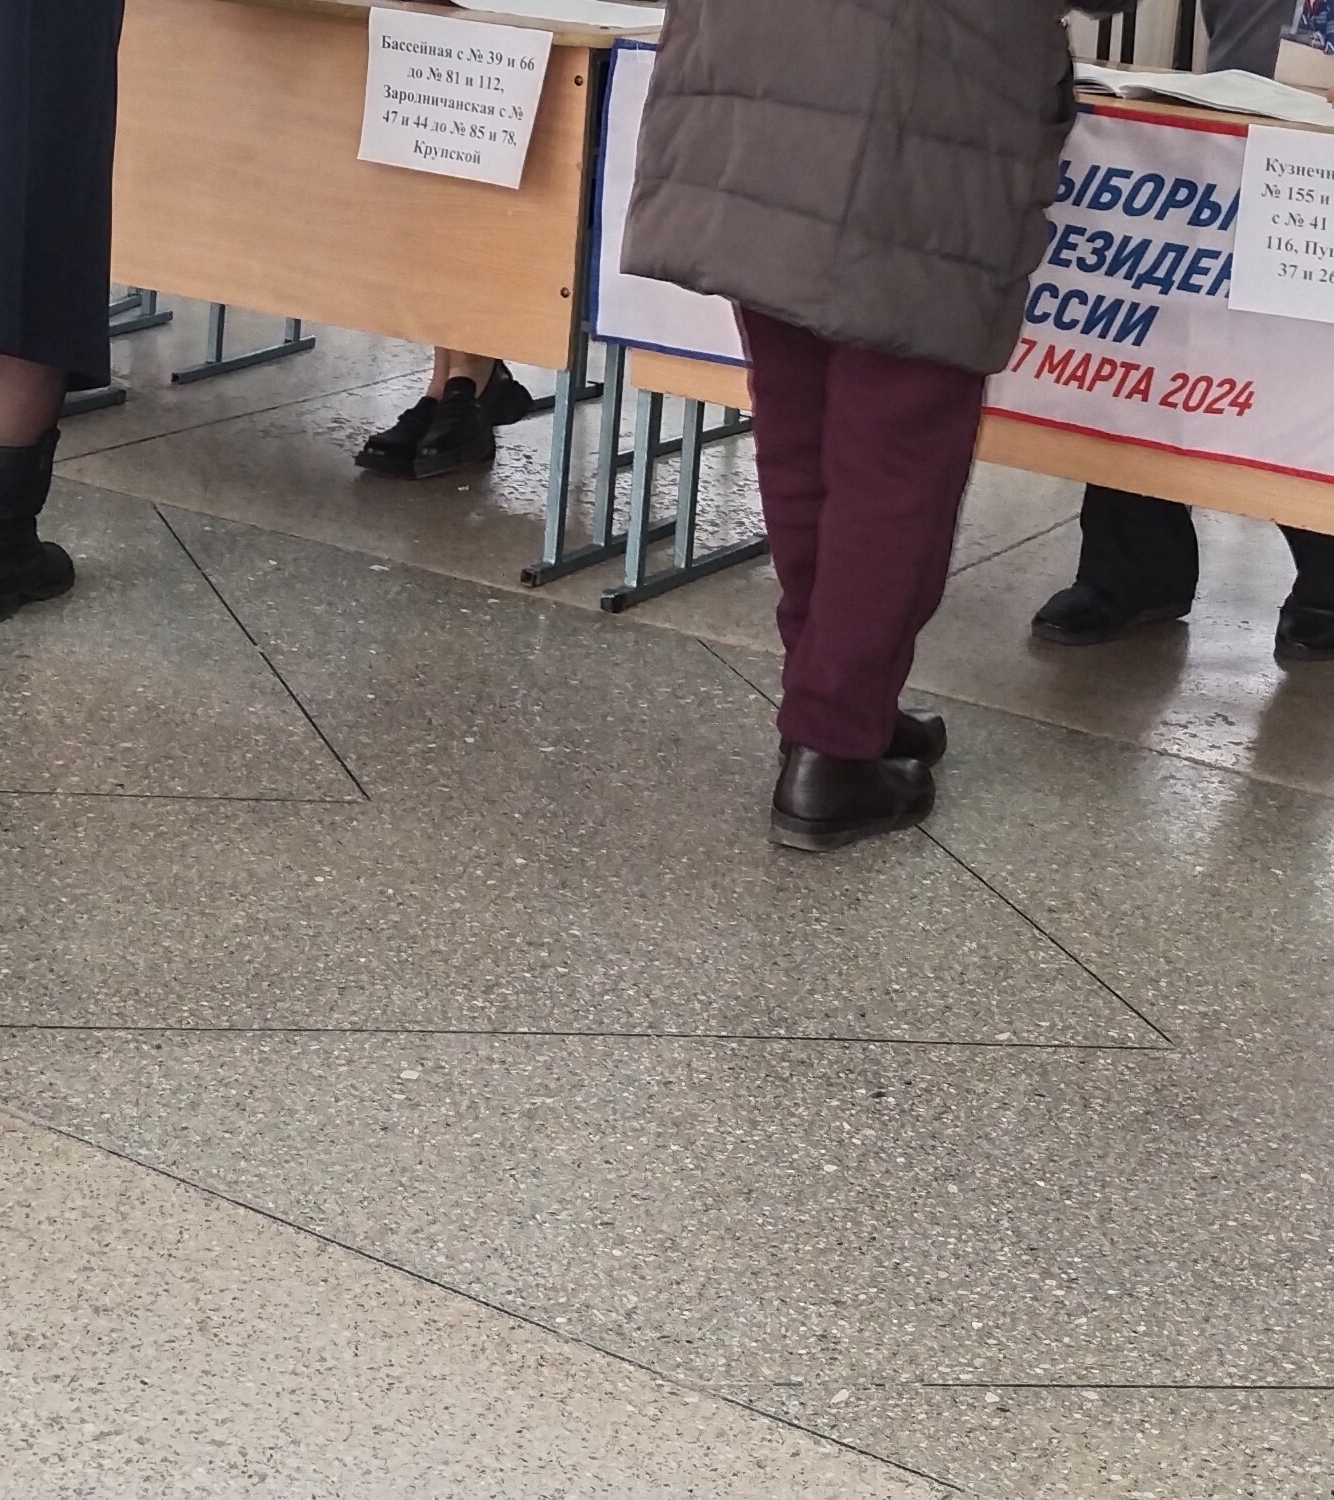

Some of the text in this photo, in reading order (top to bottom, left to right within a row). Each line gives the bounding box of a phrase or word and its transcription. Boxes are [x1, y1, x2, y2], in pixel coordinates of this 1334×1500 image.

[381, 34, 535, 71] Бассейная с № 39 и 66
[407, 66, 505, 93] до № 81 и 112,
[499, 106, 507, 118] с
[508, 106, 524, 121] №
[382, 109, 517, 148] 47 и 44 до № 85 и 78,
[413, 139, 481, 165] Крупской
[1261, 183, 1281, 199] №
[1287, 186, 1315, 204] 155
[1319, 194, 1330, 205] и
[1271, 214, 1280, 225] с
[1284, 212, 1304, 228] №
[1309, 216, 1327, 231] 41
[1266, 236, 1298, 254] 116,
[1277, 263, 1298, 279] 37
[1302, 270, 1313, 281] и
[1034, 344, 1155, 403] МАРТА
[1158, 372, 1255, 417] 2024
